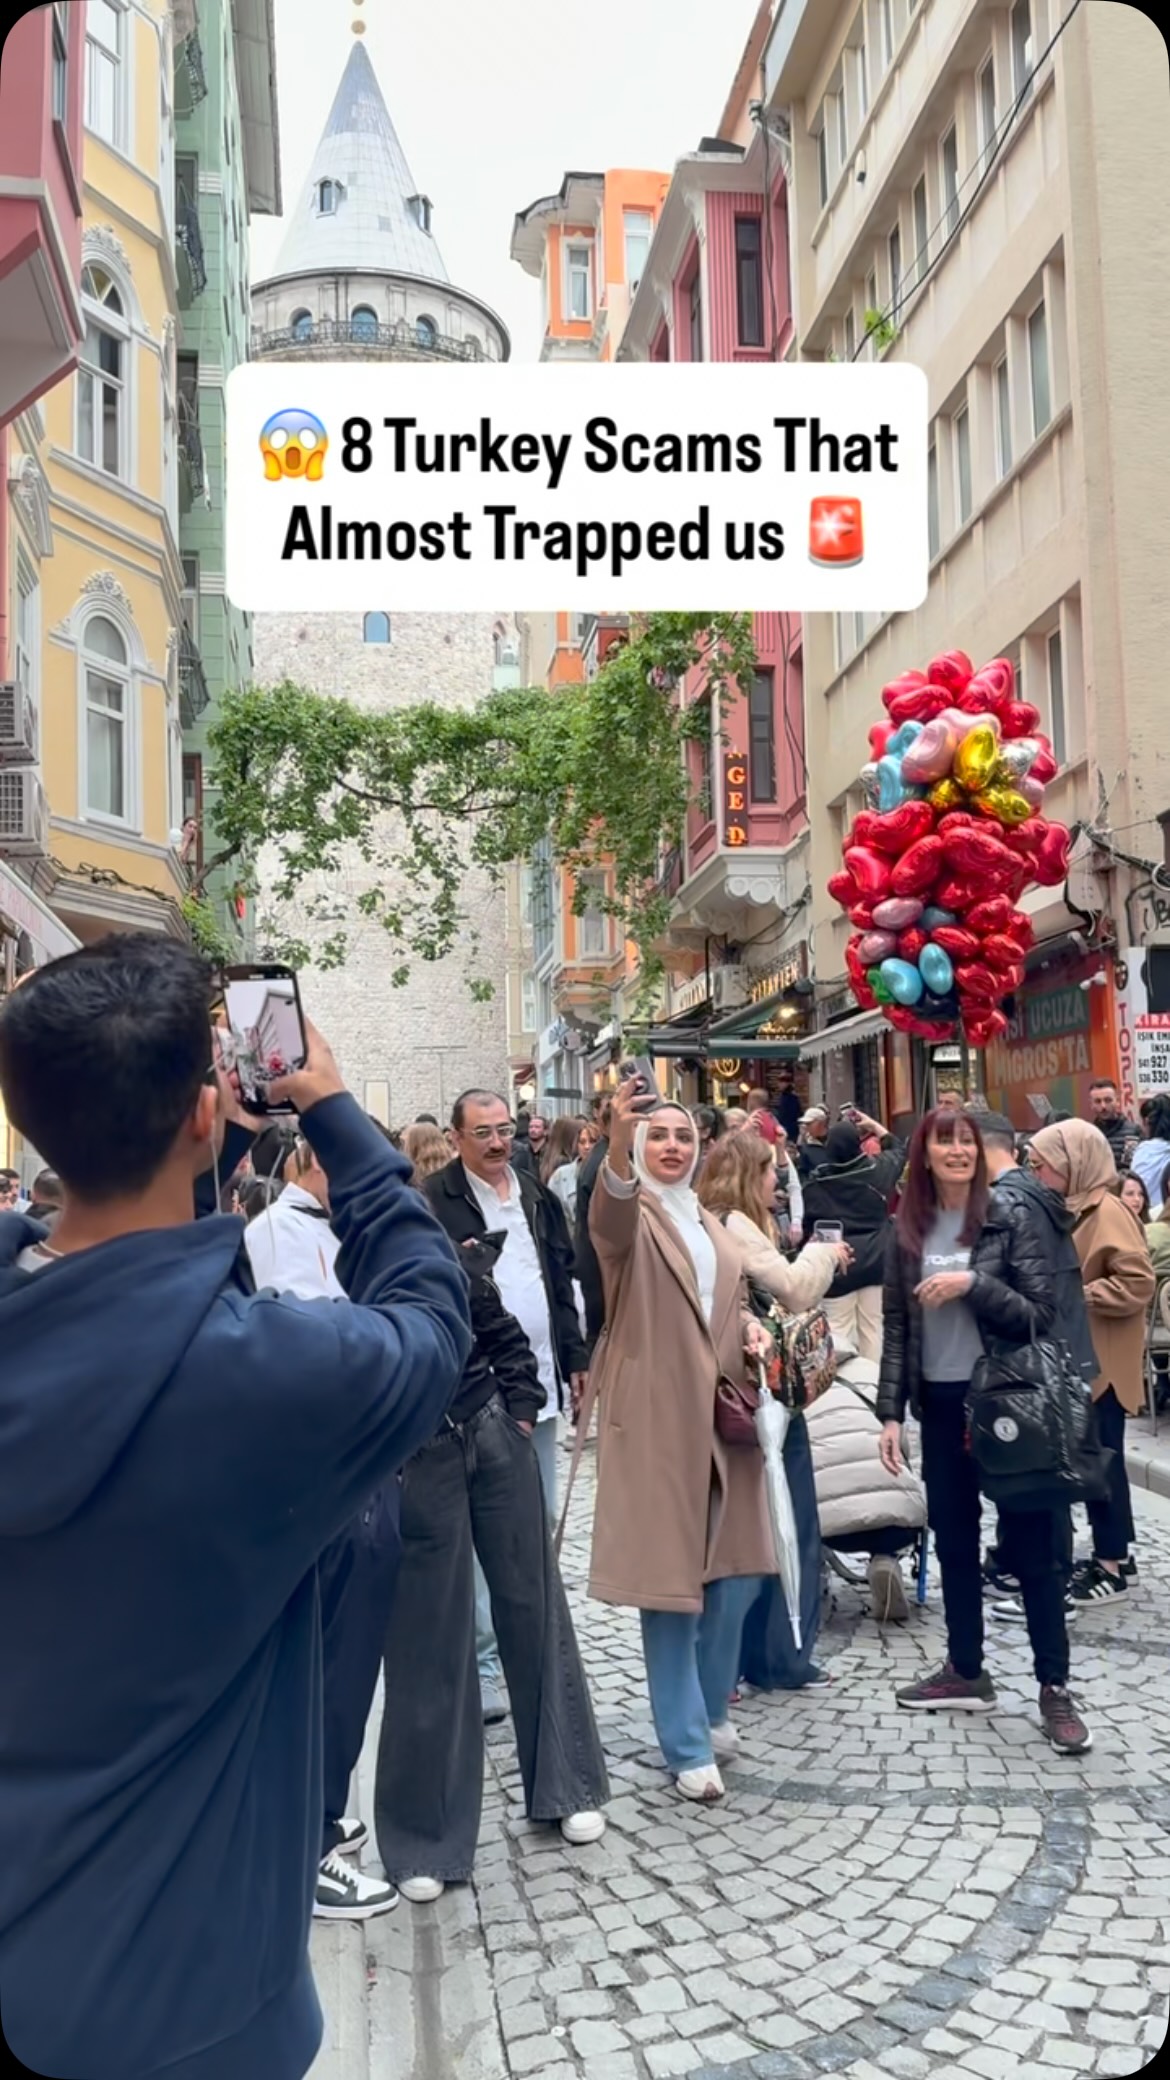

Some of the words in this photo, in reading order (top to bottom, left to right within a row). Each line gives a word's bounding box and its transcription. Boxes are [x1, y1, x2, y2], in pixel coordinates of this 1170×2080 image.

[1029, 989, 1087, 1034] UCUZA
[1150, 1055, 1167, 1068] 927
[1151, 1070, 1169, 1083] 330
